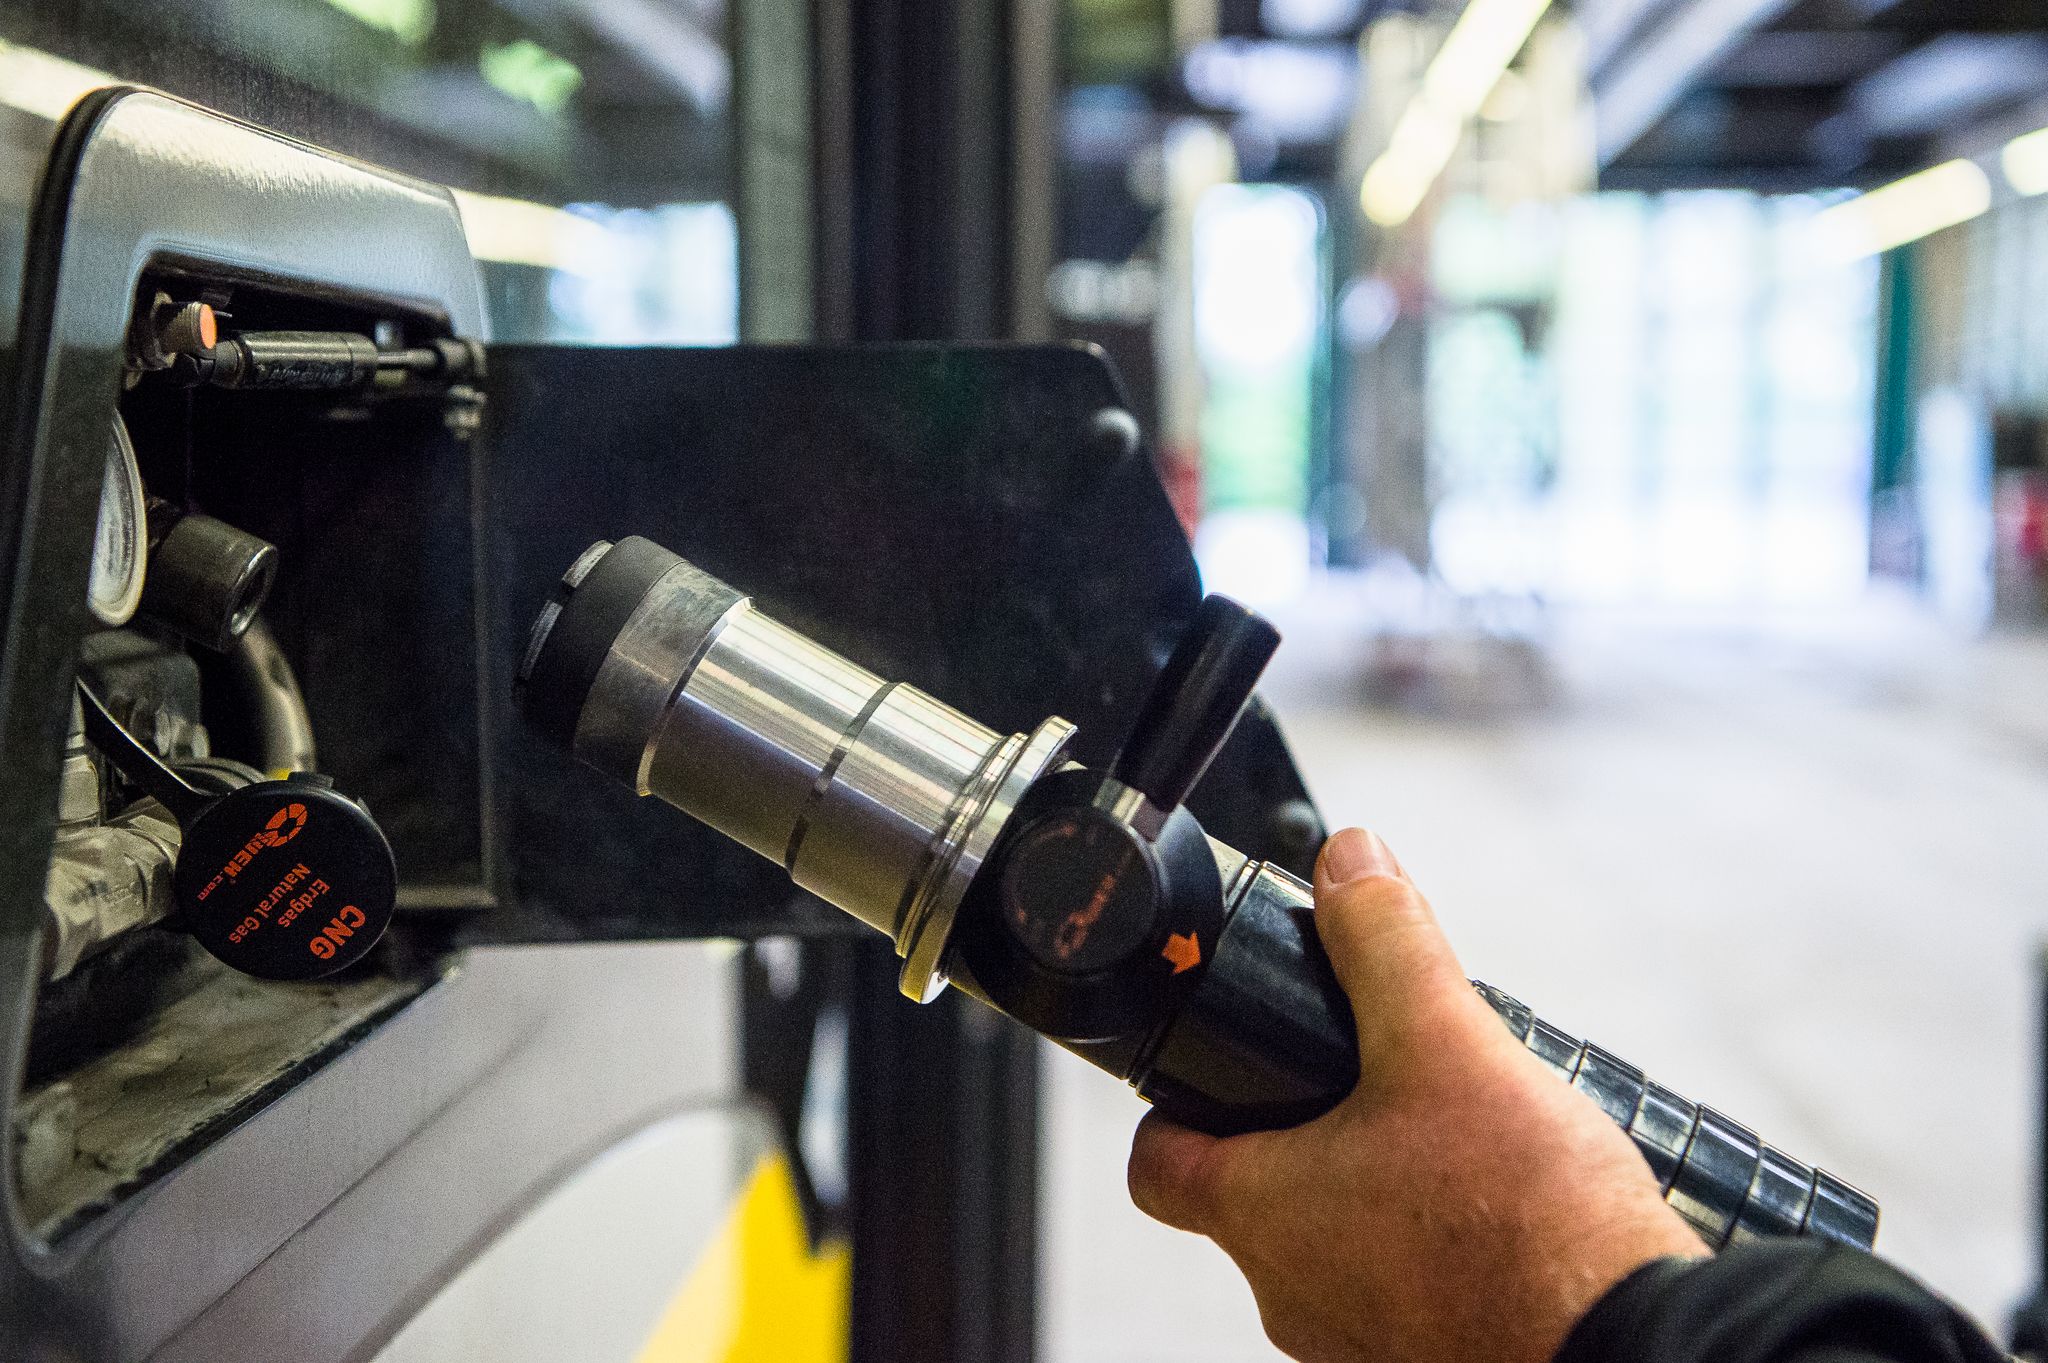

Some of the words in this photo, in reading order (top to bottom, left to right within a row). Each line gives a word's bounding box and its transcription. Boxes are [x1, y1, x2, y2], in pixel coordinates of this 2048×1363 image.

[254, 863, 312, 918] Natural
[278, 879, 331, 927] Erdgas
[229, 917, 260, 943] Gas
[310, 905, 366, 959] CNG
